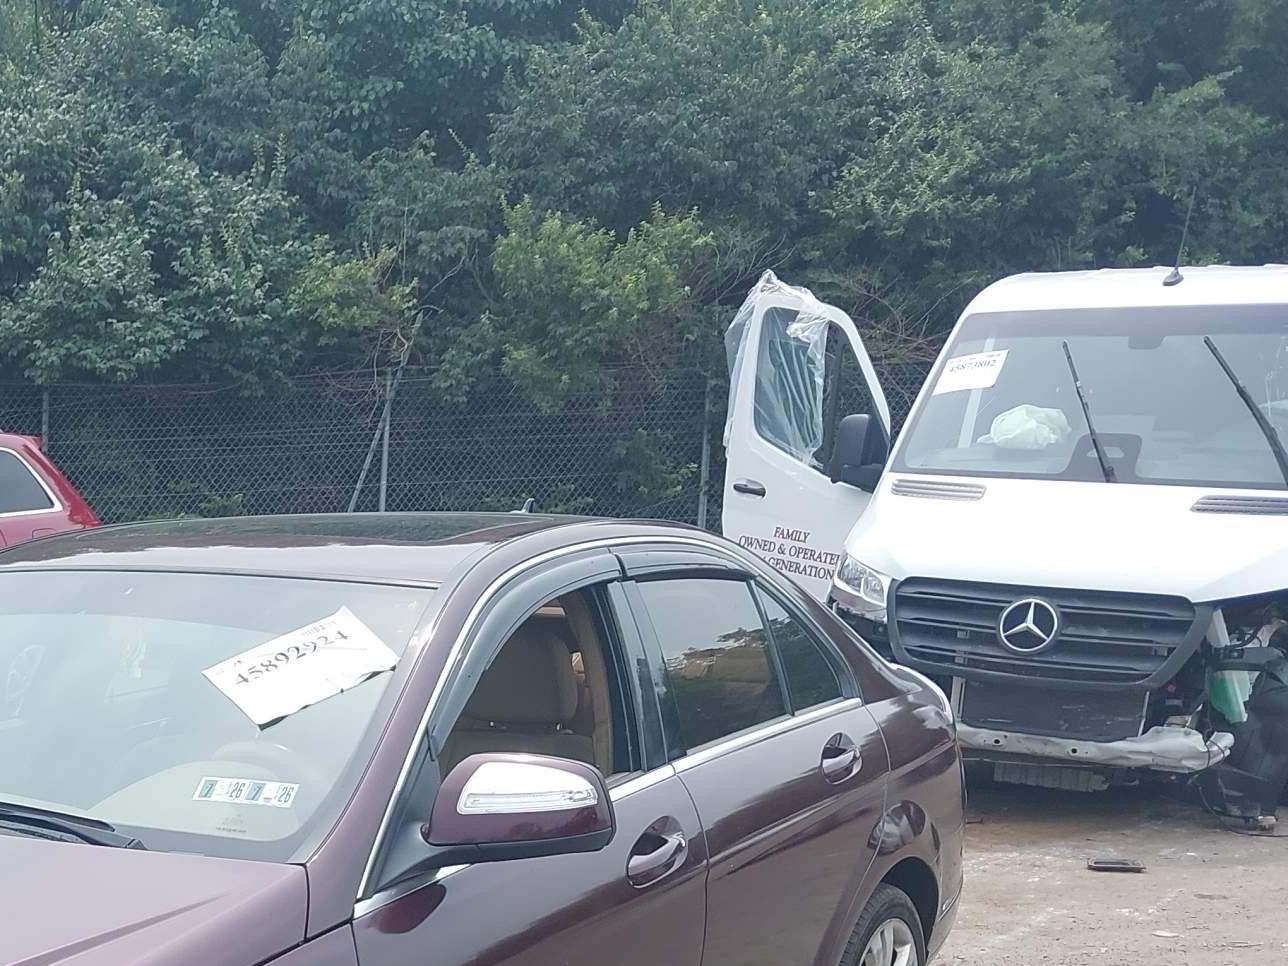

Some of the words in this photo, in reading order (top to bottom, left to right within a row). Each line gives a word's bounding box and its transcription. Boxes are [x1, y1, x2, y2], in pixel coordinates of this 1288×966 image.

[773, 527, 810, 543] FAMILY
[738, 535, 776, 552] OWNED
[777, 543, 786, 555] &
[235, 630, 349, 685] 45892924
[229, 781, 247, 799] 26
